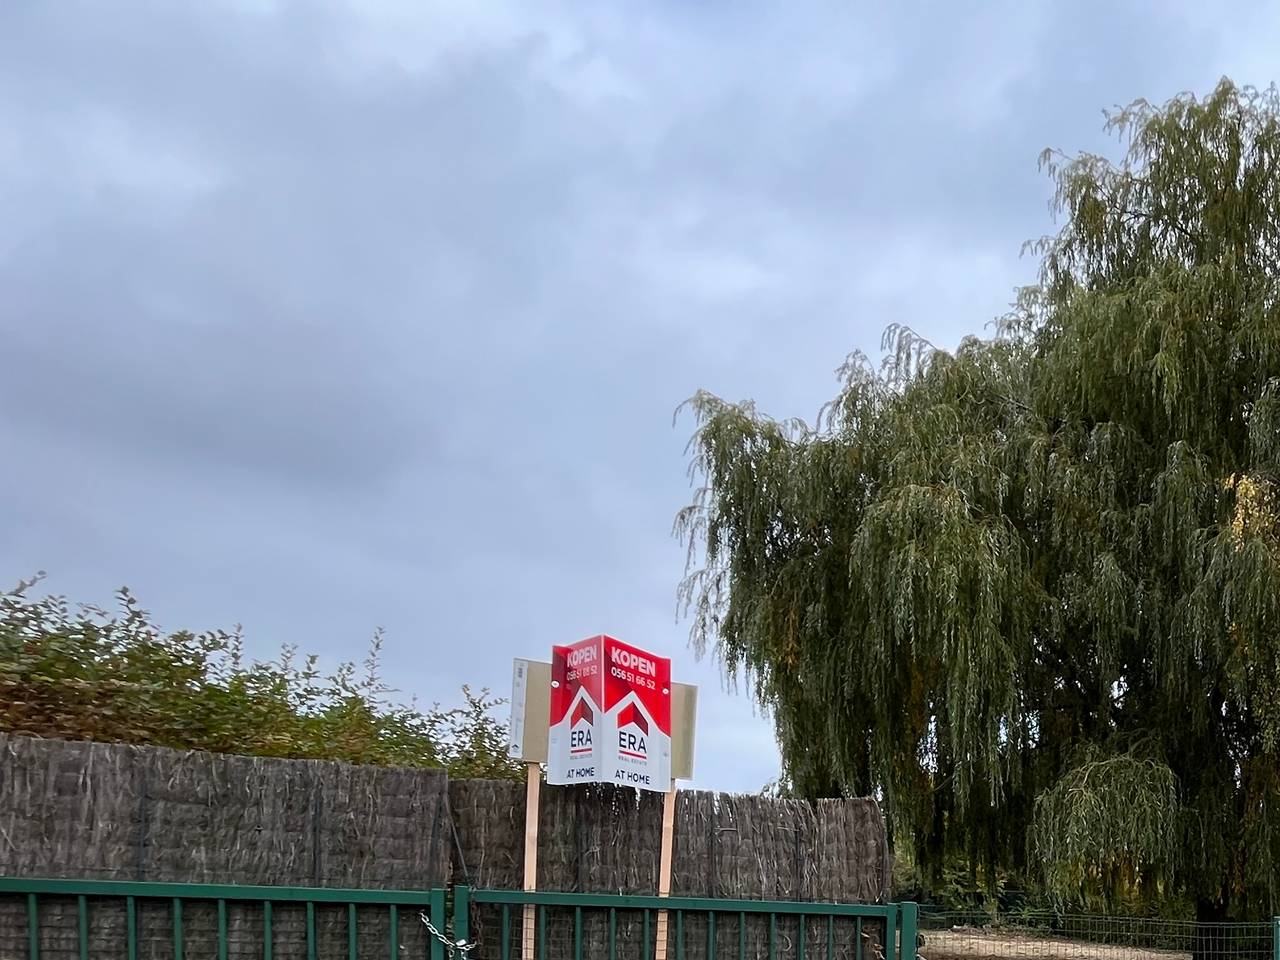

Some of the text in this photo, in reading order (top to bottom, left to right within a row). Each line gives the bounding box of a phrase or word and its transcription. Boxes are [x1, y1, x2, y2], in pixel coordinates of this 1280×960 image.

[567, 645, 597, 667] KOPEN
[611, 647, 656, 676] KOPEN
[611, 667, 626, 680] 056
[646, 678, 656, 690] 52
[571, 729, 592, 747] ERA
[619, 731, 647, 753] ERA
[567, 767, 595, 778] AT HOME
[615, 769, 650, 784] AT HOME
